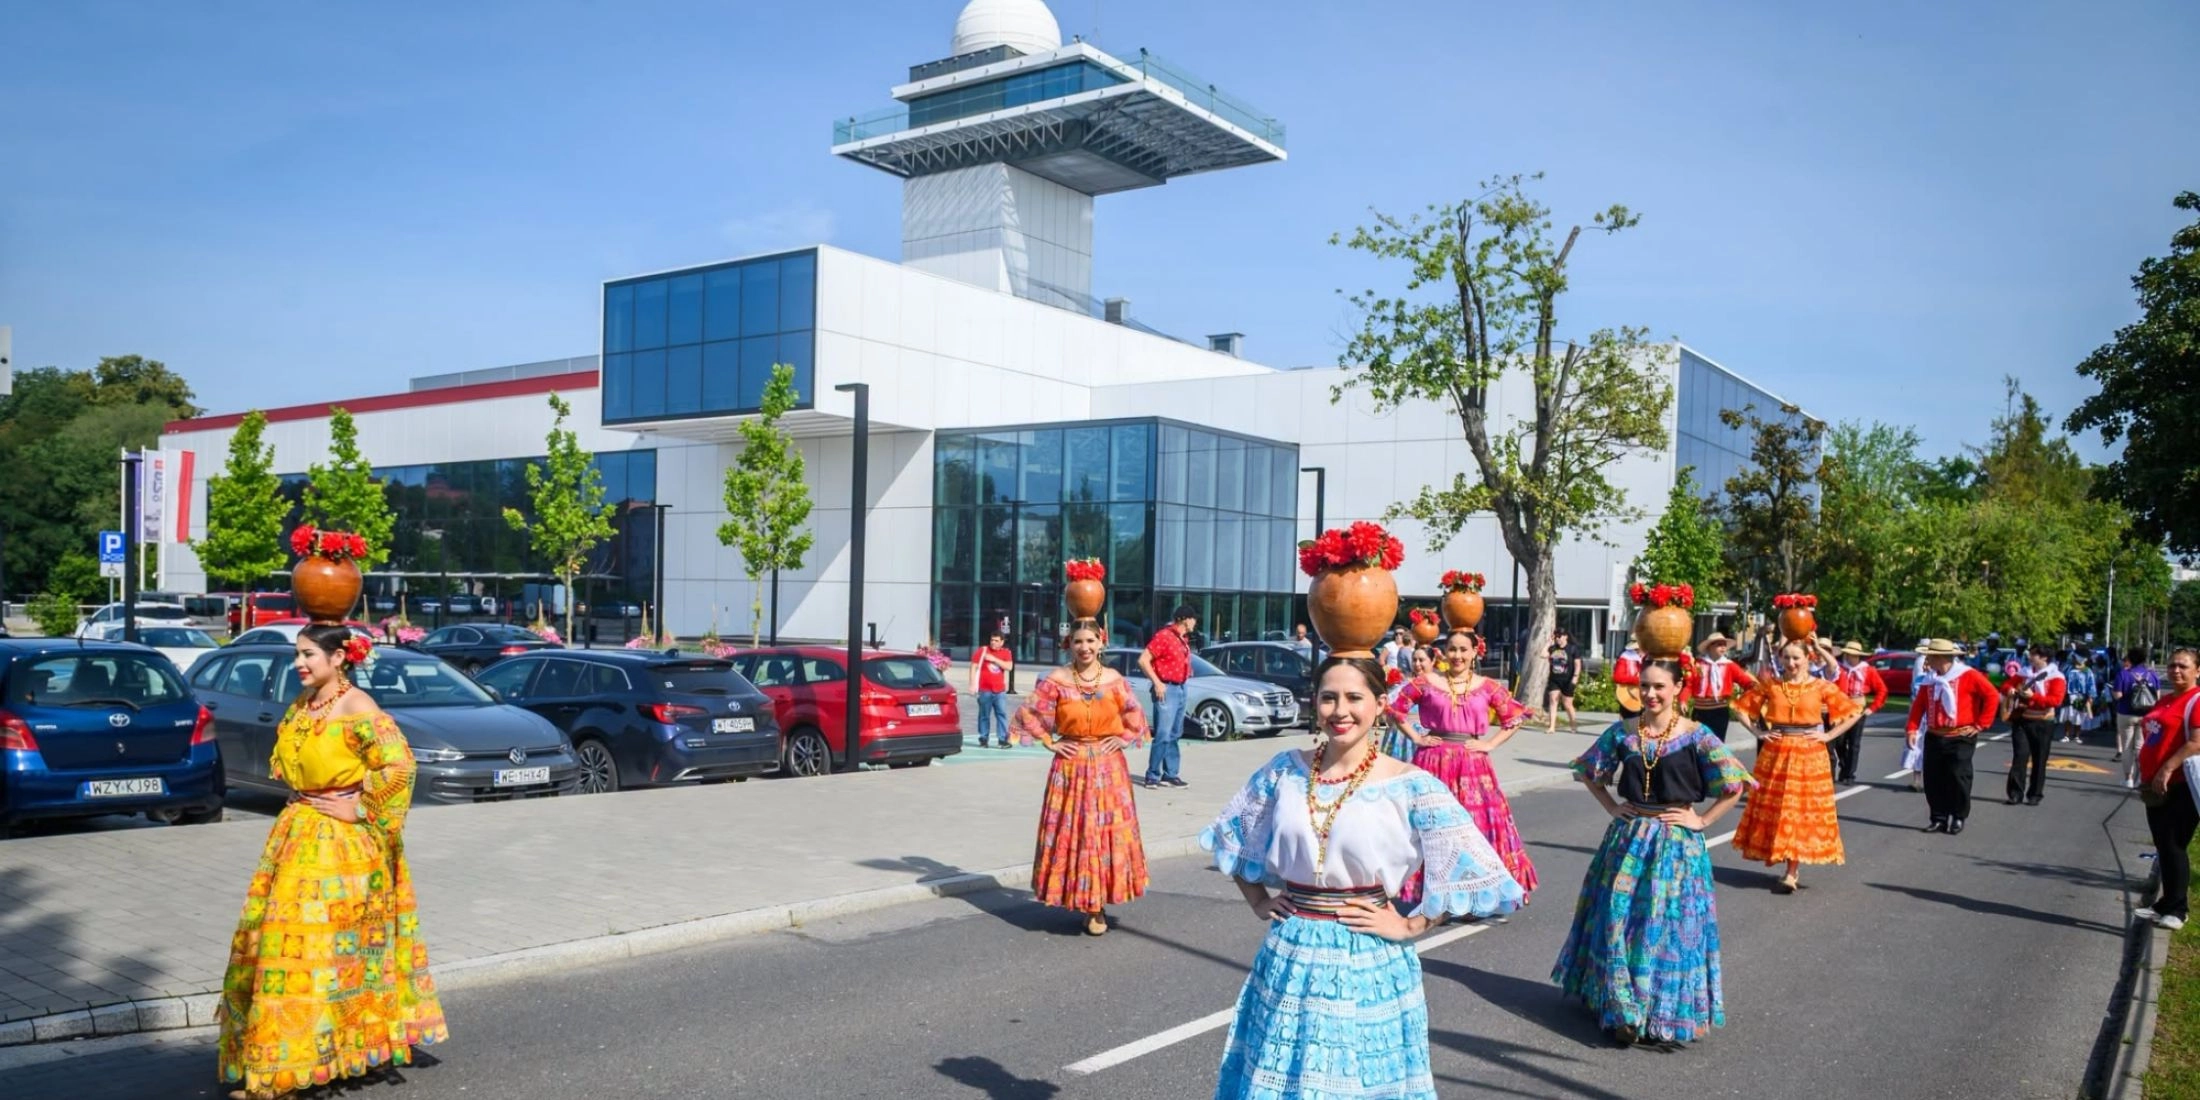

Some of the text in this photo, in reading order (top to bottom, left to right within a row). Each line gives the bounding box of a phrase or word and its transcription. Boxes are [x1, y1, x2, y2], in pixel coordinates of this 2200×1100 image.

[106, 534, 121, 554] P
[502, 770, 514, 783] WE
[92, 779, 159, 794] WZY KJ98
